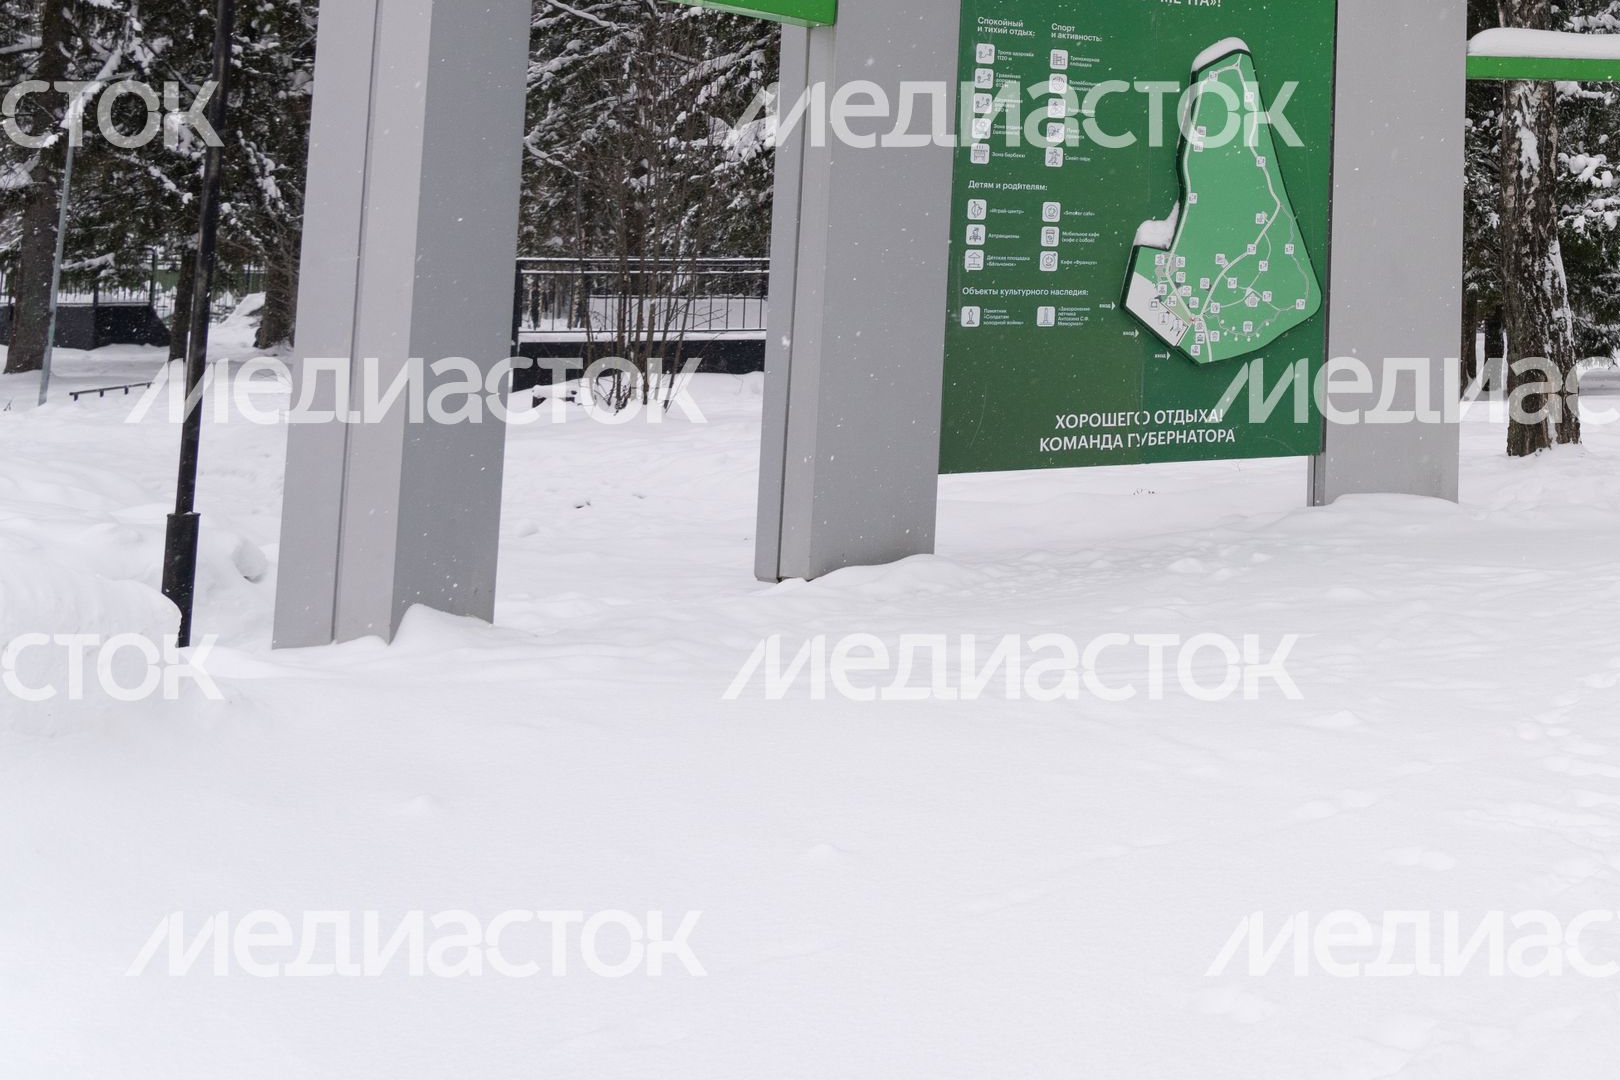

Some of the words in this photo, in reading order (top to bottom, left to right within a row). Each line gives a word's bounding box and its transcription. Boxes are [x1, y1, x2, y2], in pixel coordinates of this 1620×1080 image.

[977, 16, 1024, 27] Спокойный
[984, 26, 1008, 34] тихий
[1009, 28, 1035, 37] отдых:
[1051, 23, 1076, 33] Спорт
[1057, 33, 1103, 42] активность:
[968, 180, 994, 189] Детям
[1002, 182, 1048, 191] родителям:
[962, 287, 999, 295] Объекты
[1000, 288, 1049, 297] культурного
[1055, 411, 1150, 430] ХОРОШЕГО
[1154, 408, 1223, 426] ОТДЫХА!
[1039, 434, 1123, 452] КОМАНДА
[1127, 429, 1236, 447] ГУБЕРНАТОРА
